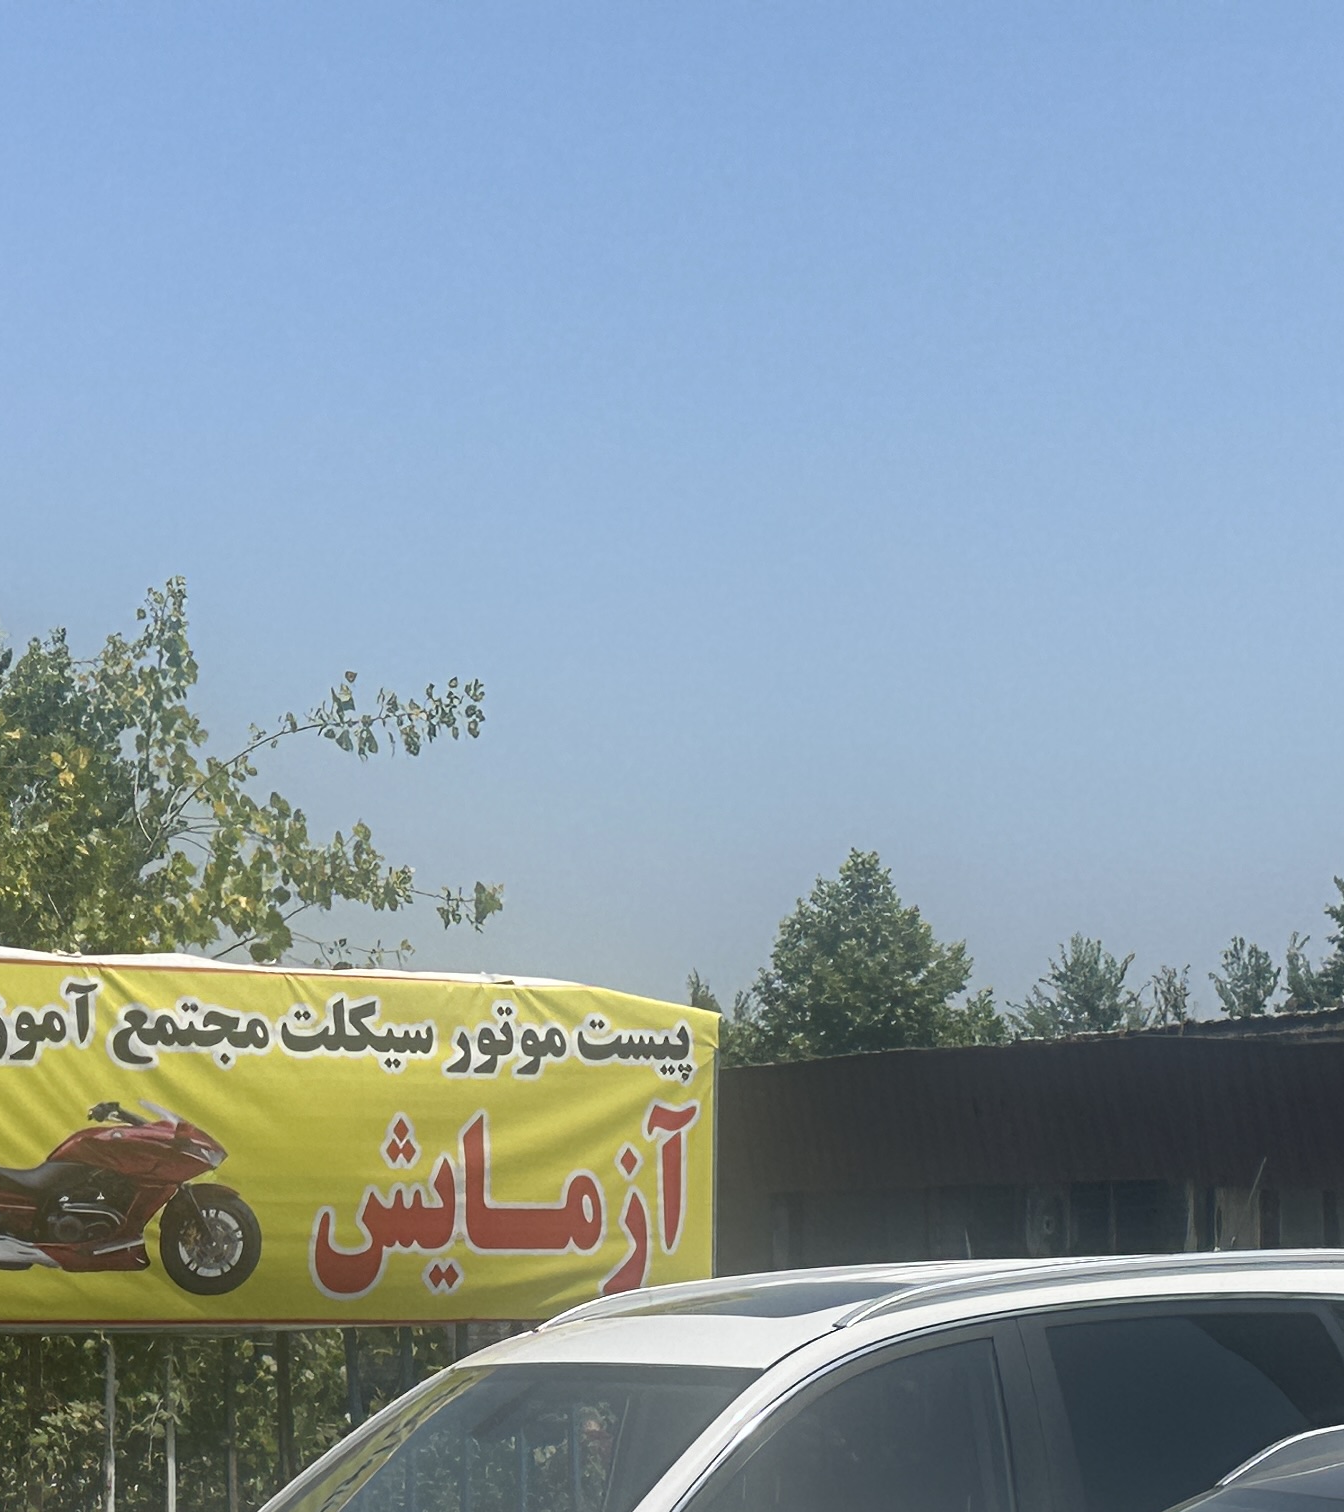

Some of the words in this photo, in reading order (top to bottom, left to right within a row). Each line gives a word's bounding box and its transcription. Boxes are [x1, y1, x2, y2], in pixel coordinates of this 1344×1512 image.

[112, 1001, 270, 1066] مجتمع
[280, 997, 434, 1069] سیکلت
[445, 1005, 567, 1075] موتور
[577, 1018, 693, 1083] پیست
[314, 1103, 698, 1295] آزمایش
